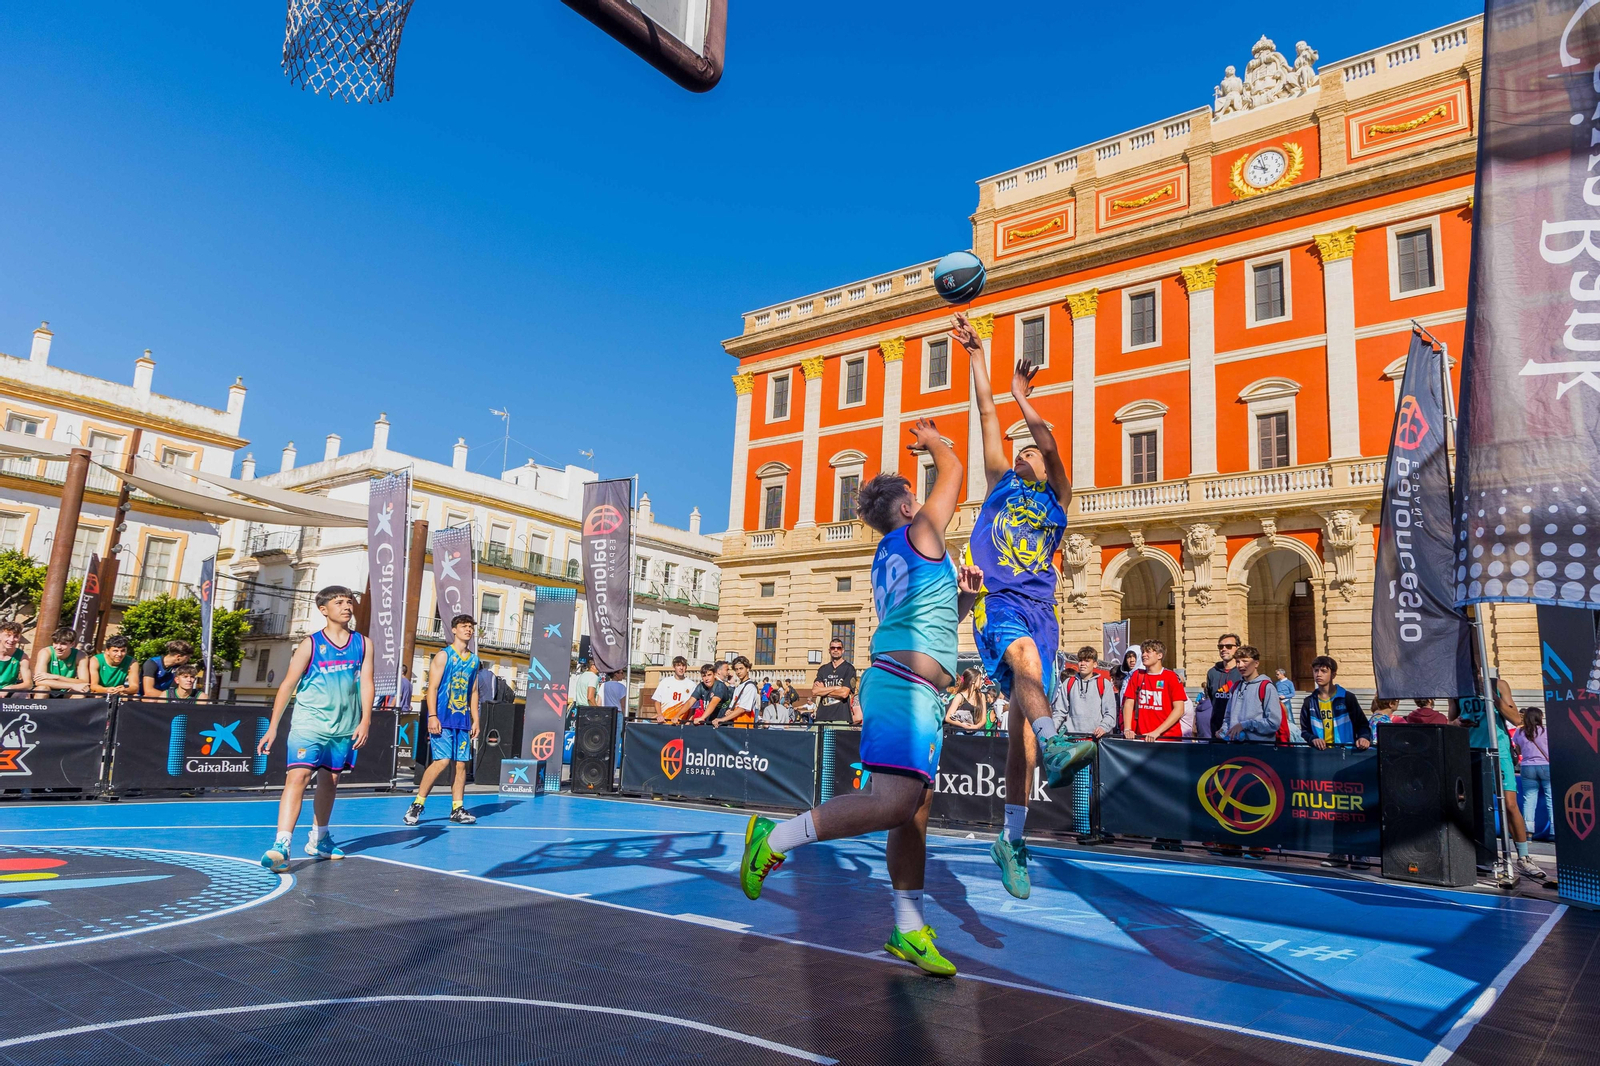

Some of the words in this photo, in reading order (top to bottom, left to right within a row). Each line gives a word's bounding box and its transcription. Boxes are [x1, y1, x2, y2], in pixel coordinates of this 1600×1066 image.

[672, 691, 681, 701] 81
[1139, 689, 1162, 706] SFN
[1215, 691, 1231, 699] adid
[186, 759, 250, 772] CaixaBank
[685, 747, 769, 772] baloncesto
[685, 767, 716, 776] ESPAÑA
[501, 785, 533, 793] CaixaBank
[1290, 779, 1364, 794] UNIVERSO
[1291, 792, 1364, 811] MUJER
[1291, 809, 1366, 822] BALONCESTO
